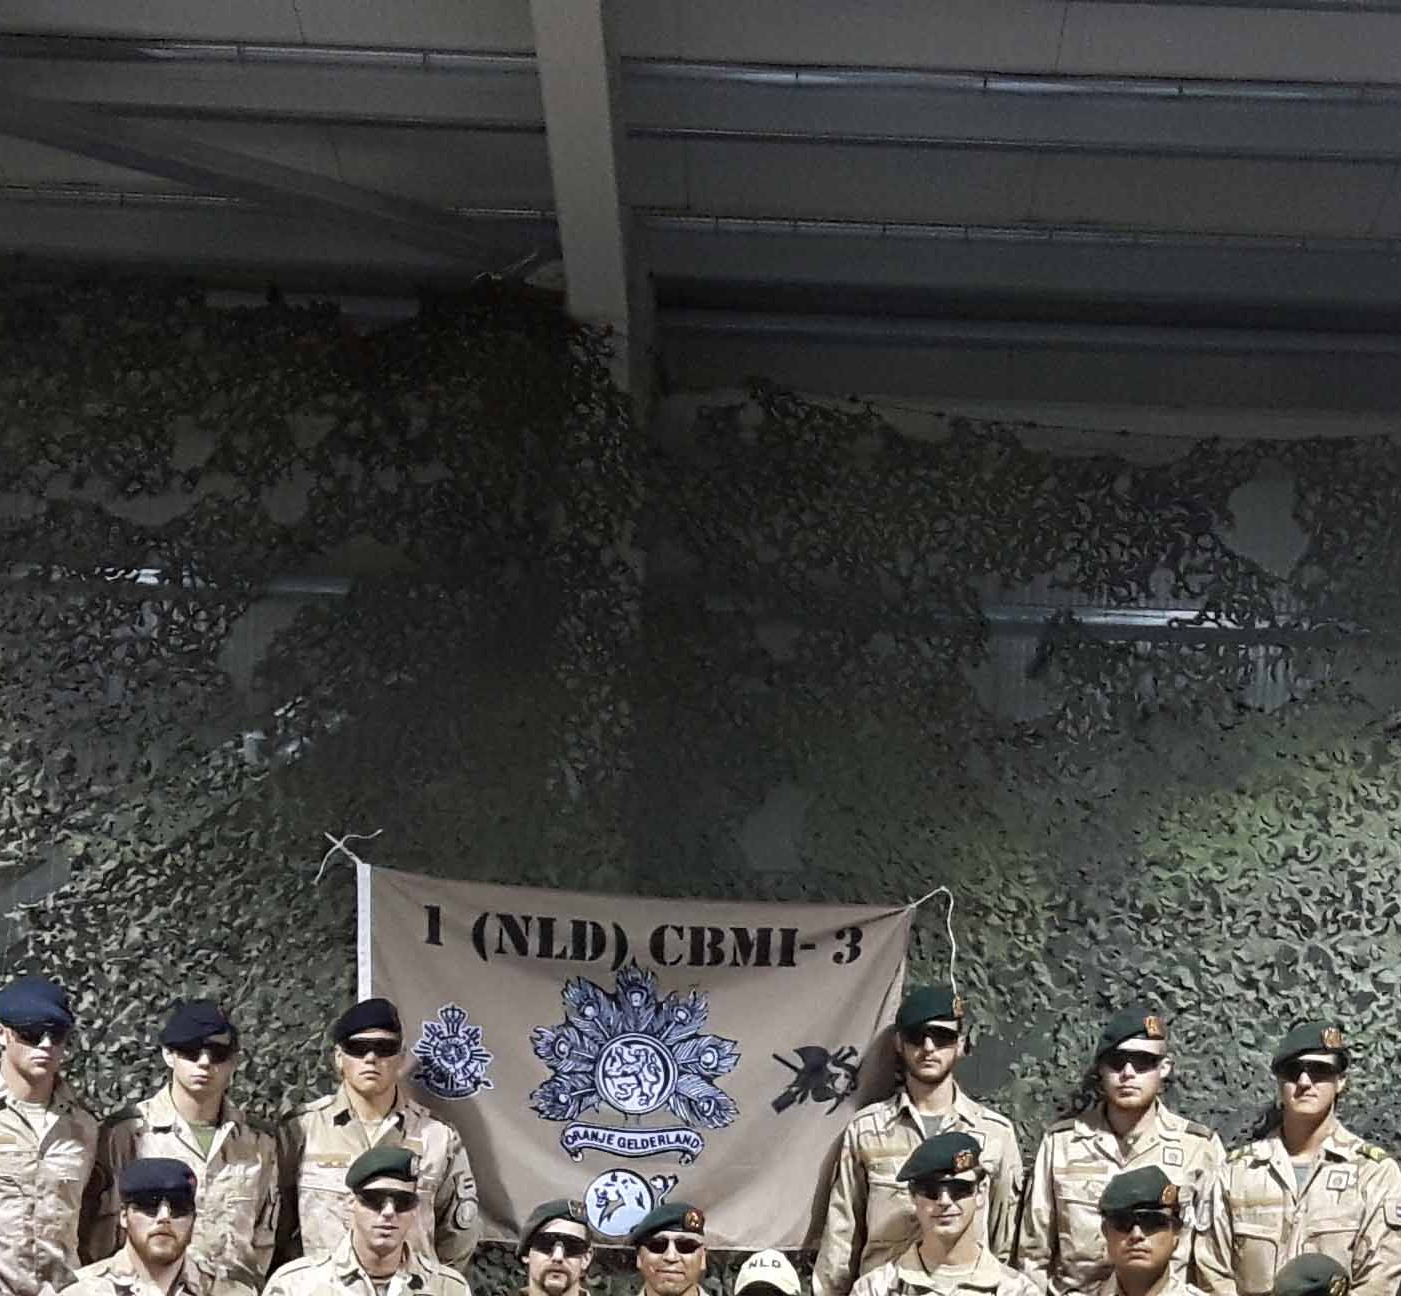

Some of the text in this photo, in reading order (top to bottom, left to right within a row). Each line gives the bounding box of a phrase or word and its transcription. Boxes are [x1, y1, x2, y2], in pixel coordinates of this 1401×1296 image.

[424, 904, 443, 946] 1
[472, 911, 628, 972] (NLD)
[565, 1130, 700, 1150] ORANJE GELDERLAND
[748, 1258, 781, 1269] NLD
